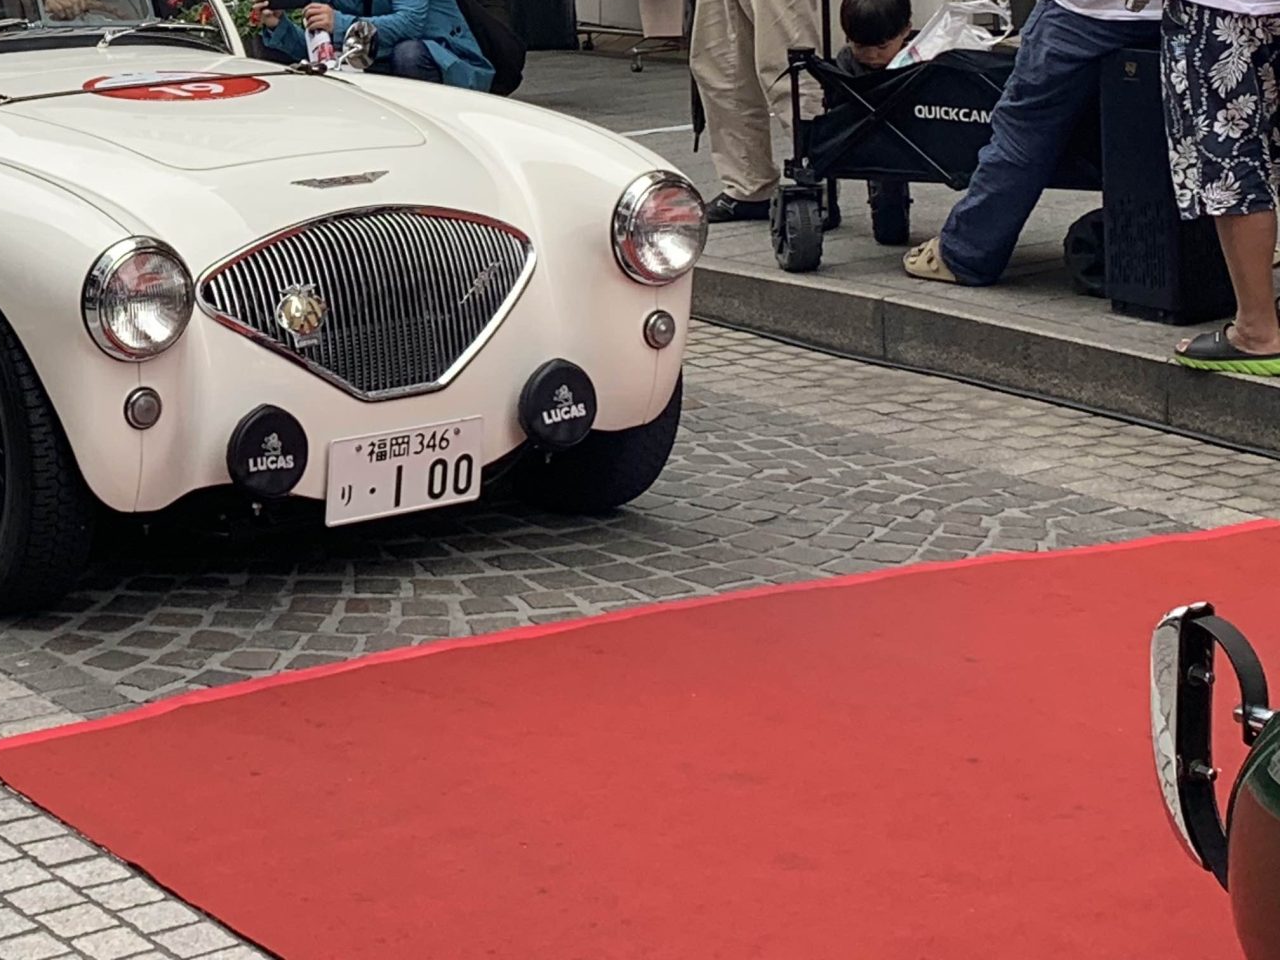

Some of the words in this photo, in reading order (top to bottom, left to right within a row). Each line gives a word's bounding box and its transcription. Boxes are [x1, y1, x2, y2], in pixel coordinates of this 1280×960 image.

[148, 82, 225, 97] 19
[542, 403, 586, 426] LUCAS
[367, 436, 410, 463] 福岡
[413, 432, 451, 455] 346
[248, 455, 294, 472] LUCAS
[340, 485, 353, 506] り
